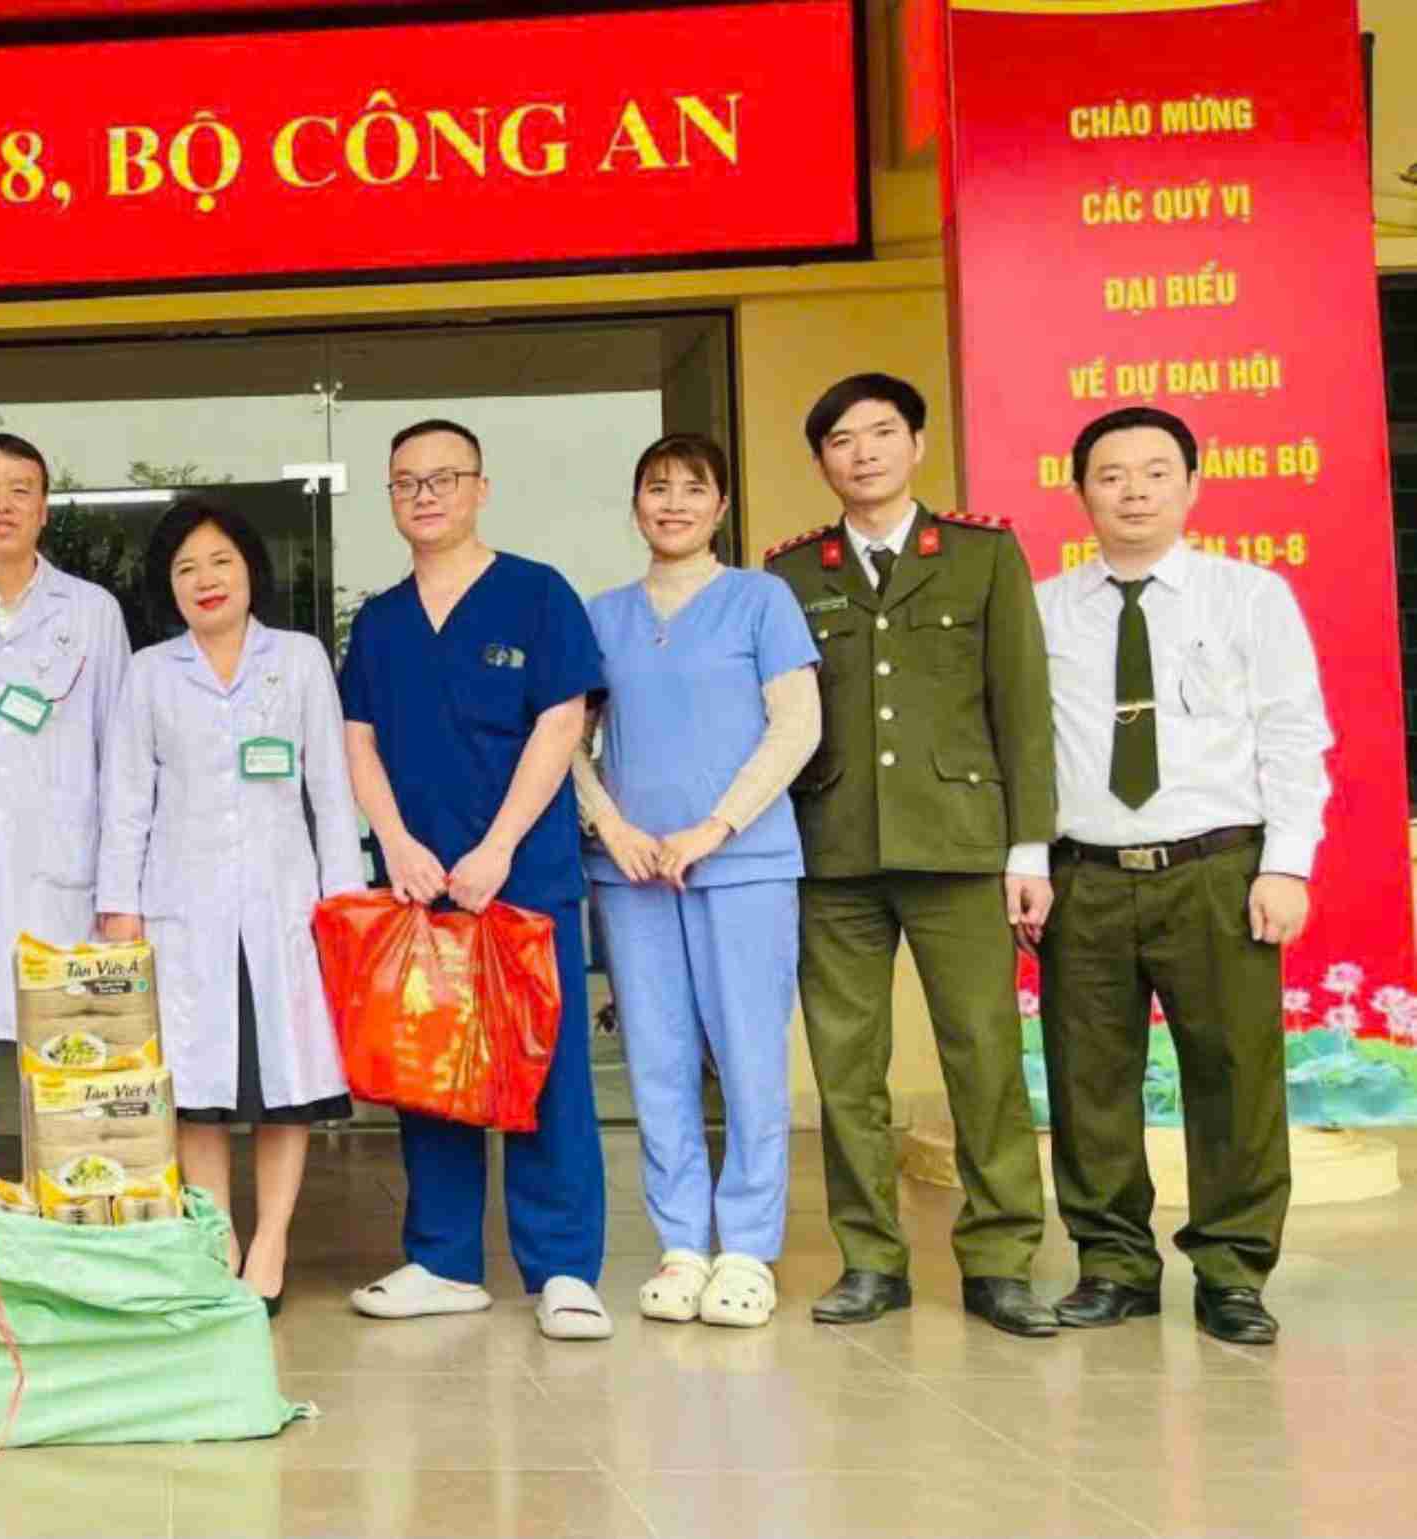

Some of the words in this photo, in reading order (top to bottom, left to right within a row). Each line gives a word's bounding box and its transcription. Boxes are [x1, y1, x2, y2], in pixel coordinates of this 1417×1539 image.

[1070, 98, 1152, 139] CHÀO
[106, 110, 243, 213] BỘ
[271, 89, 569, 189] CÔNG
[596, 93, 742, 174] AN
[1082, 185, 1143, 225] CÁC
[1221, 182, 1251, 224] VỊ
[1103, 273, 1158, 316] ĐẠI
[1165, 358, 1220, 400] ĐẠI
[1227, 351, 1281, 398] HỘI
[1200, 438, 1269, 480] ẢNG
[1276, 436, 1320, 485] BỘ
[1235, 533, 1306, 567] 19-8
